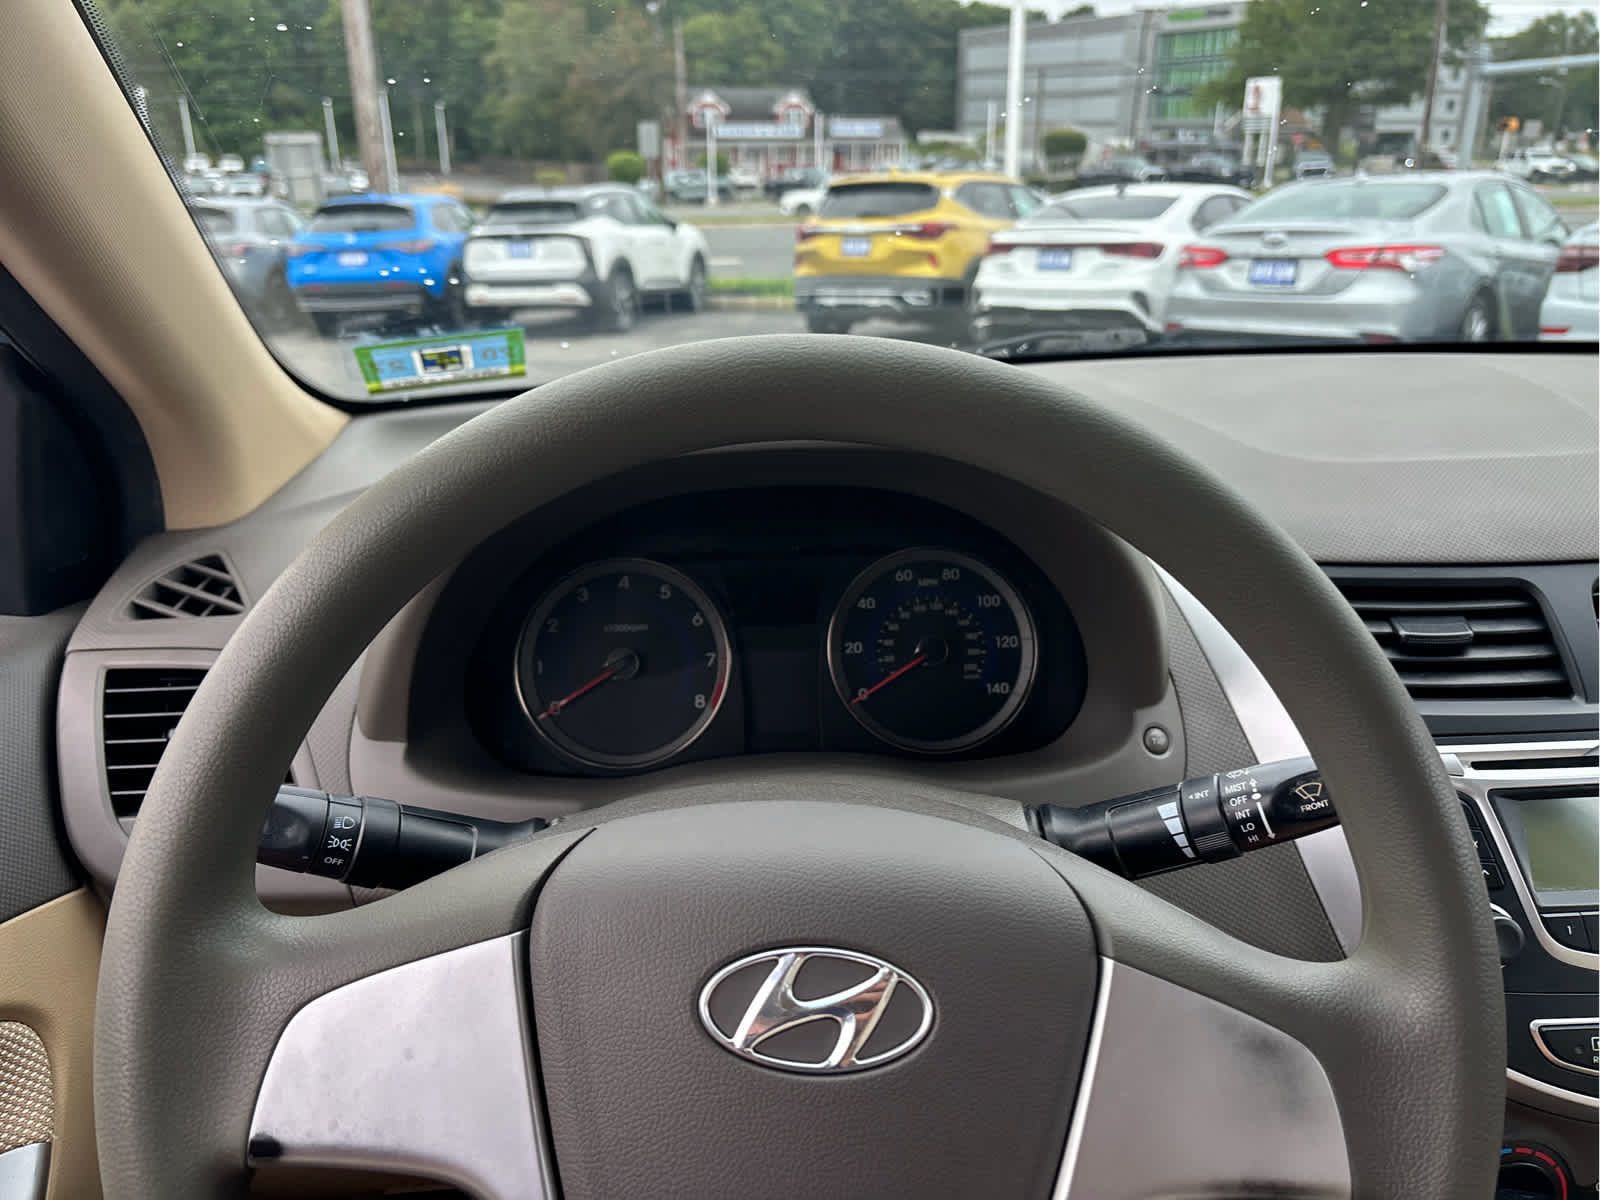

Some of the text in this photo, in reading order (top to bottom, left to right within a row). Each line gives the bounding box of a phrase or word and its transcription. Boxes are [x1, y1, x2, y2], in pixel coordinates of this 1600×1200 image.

[895, 568, 913, 582] 60
[942, 568, 960, 581] 80
[618, 575, 630, 590] 4
[577, 588, 588, 601] 3
[659, 585, 671, 599] 5
[857, 598, 876, 609] 40
[977, 595, 1001, 608] 100
[547, 619, 559, 633] 2
[692, 613, 703, 626] 6
[844, 641, 863, 654] 20
[995, 635, 1019, 649] 120
[705, 653, 716, 667] 7
[537, 661, 543, 675] 1
[986, 683, 1010, 695] 140
[694, 694, 706, 708] 8
[1194, 790, 1210, 799] INT
[1224, 782, 1248, 795] MIST
[1229, 796, 1248, 807] OFF
[1301, 799, 1329, 813] FRONT
[1234, 809, 1251, 820] INT
[1241, 822, 1255, 833] LO
[1248, 835, 1260, 843] HI
[323, 857, 345, 865] OFF
[1567, 925, 1572, 936] 1
